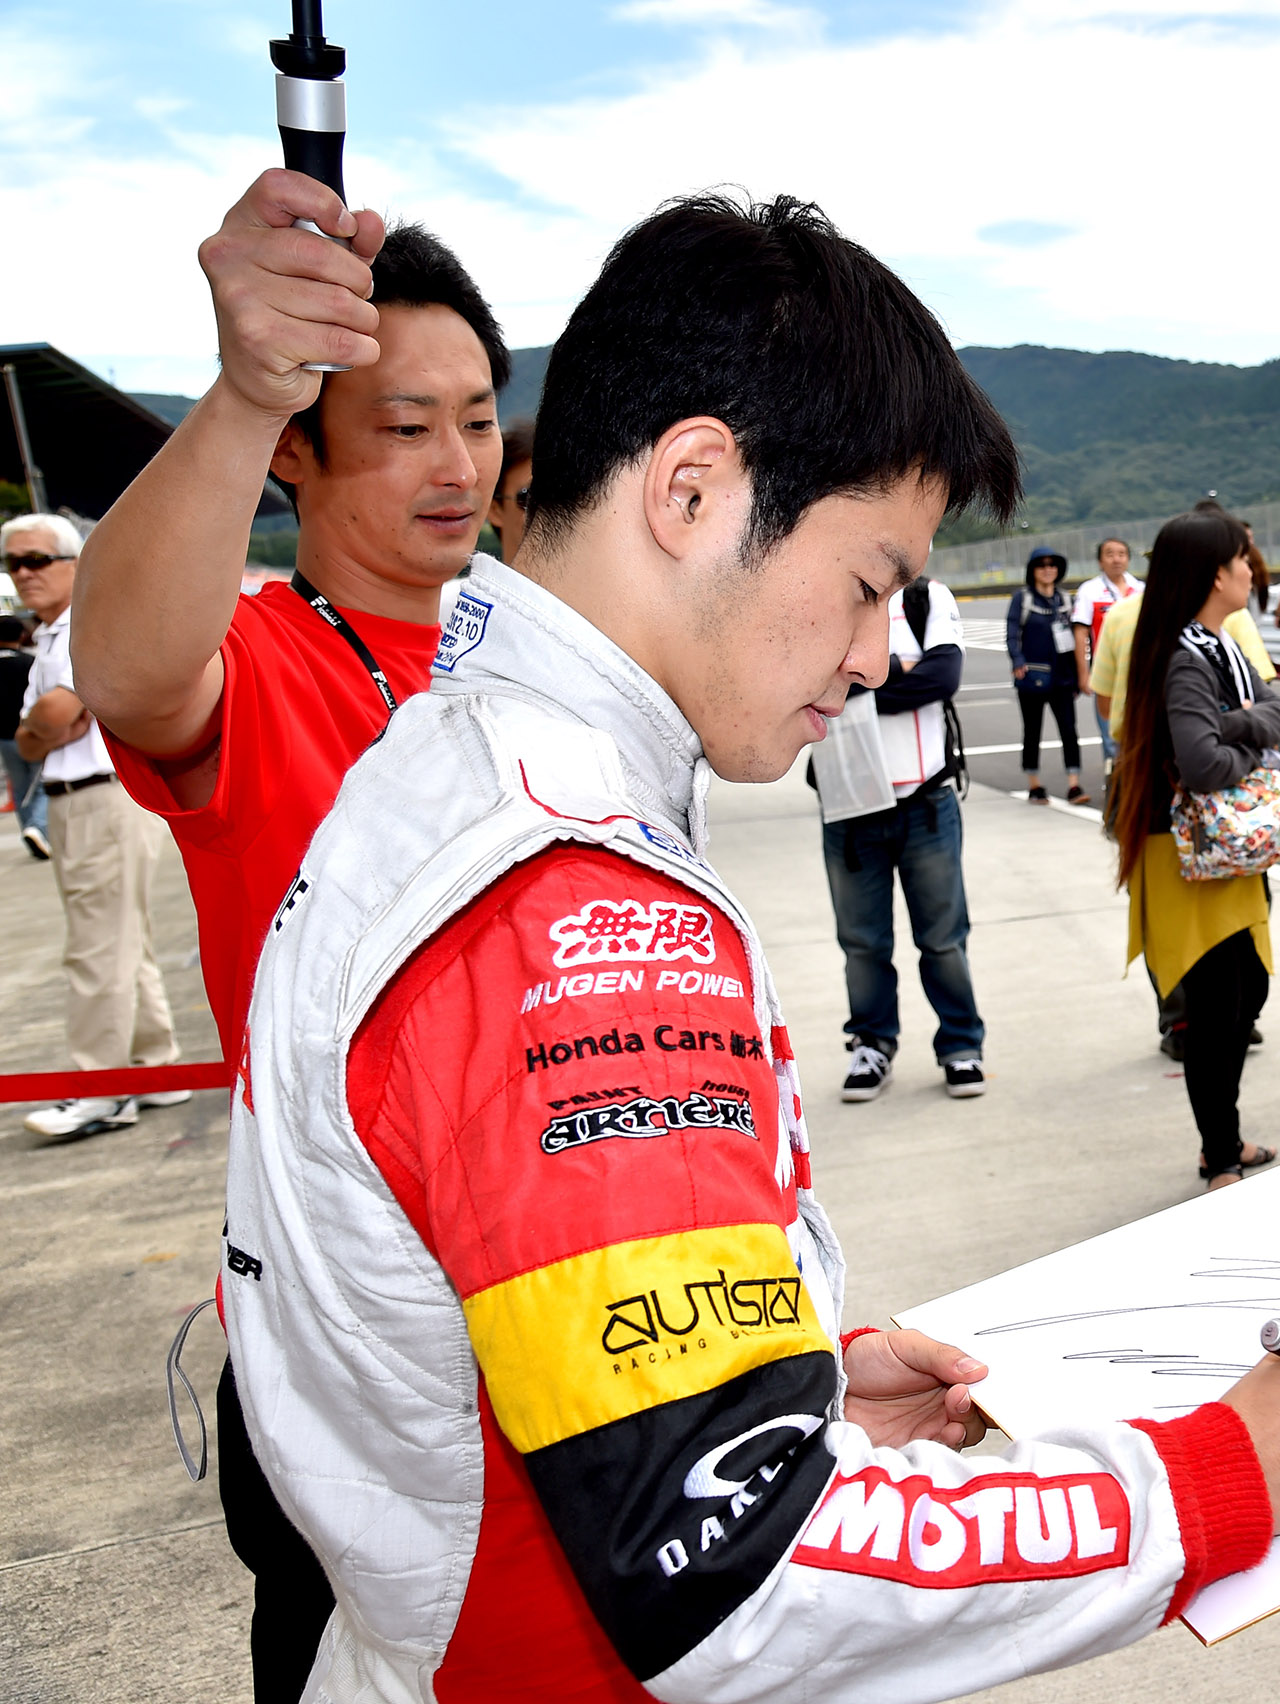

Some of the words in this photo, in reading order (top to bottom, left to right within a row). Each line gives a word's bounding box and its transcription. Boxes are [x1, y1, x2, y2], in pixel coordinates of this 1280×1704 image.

[553, 901, 715, 965] 無限
[521, 970, 644, 1015] MUGEN
[526, 1028, 645, 1074] Honda
[654, 1024, 725, 1052] Cars
[612, 1337, 707, 1375] RACING
[799, 1480, 1118, 1573] MOTUL
